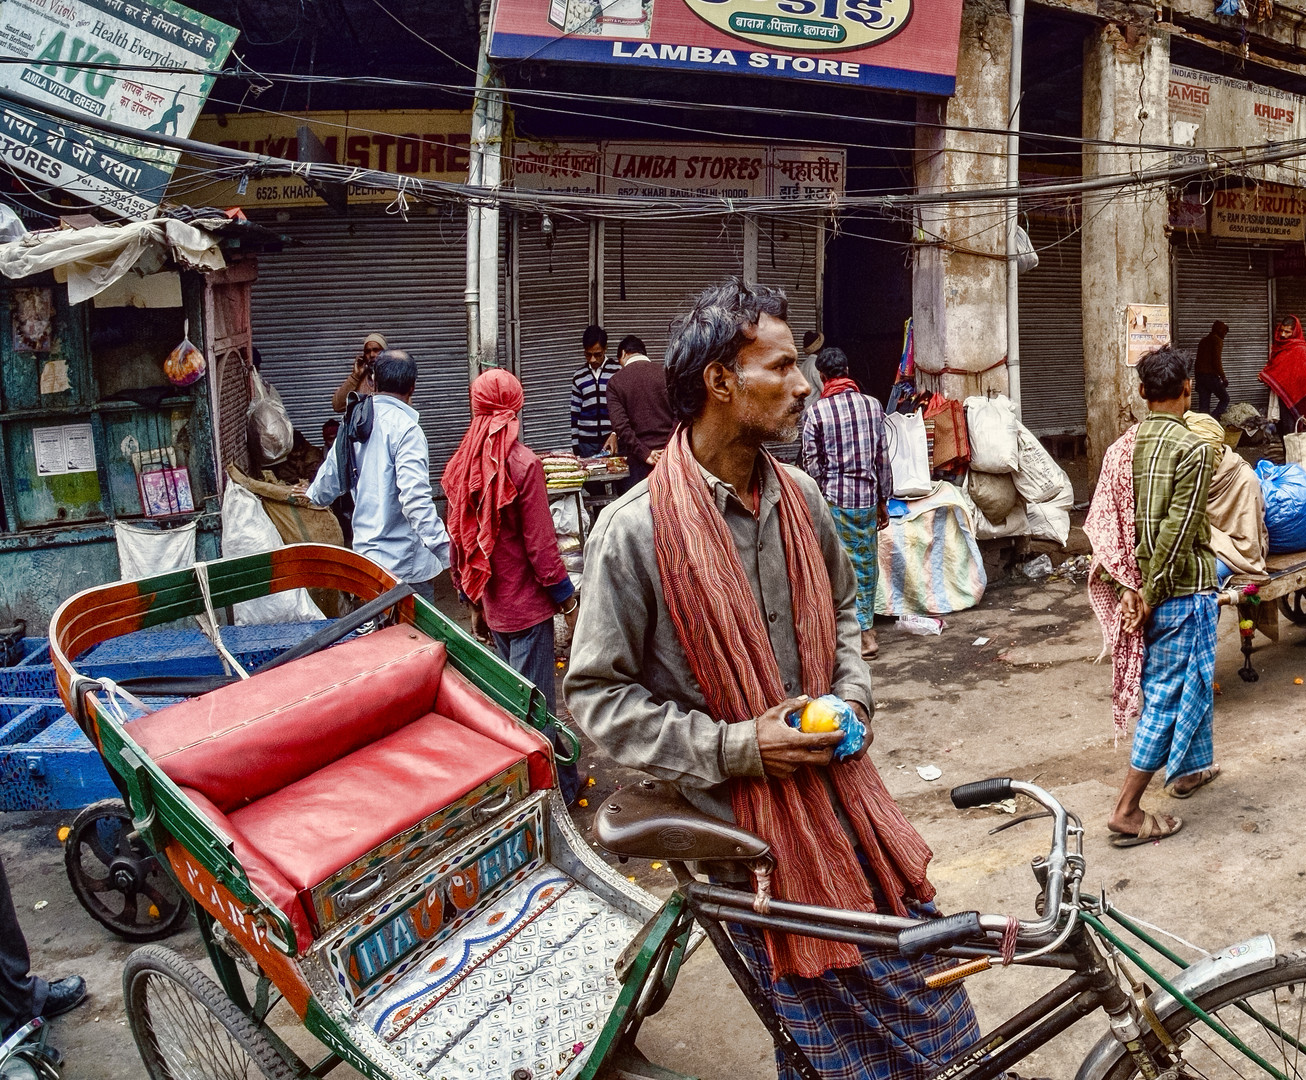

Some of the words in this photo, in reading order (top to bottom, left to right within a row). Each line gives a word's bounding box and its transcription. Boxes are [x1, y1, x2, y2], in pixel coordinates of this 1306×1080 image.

[152, 13, 181, 38] बीमार
[205, 34, 217, 53] से
[735, 16, 765, 30] बादाम
[770, 17, 798, 34] पिस्ता
[803, 25, 840, 39] इलायची
[90, 20, 131, 50] Health
[128, 37, 188, 76] Everyday!
[612, 41, 737, 66] LAMBA
[748, 52, 861, 79] STORE
[31, 30, 121, 99] AVG
[23, 71, 48, 91] AMLA
[48, 83, 72, 102] VITAL
[72, 94, 103, 116] GREEN
[1171, 68, 1198, 81] INDIA'S
[1199, 74, 1224, 86] FINEST
[1224, 79, 1259, 95] WEIGHING
[1259, 86, 1285, 101] SCALES
[1285, 92, 1293, 101] IN
[612, 153, 677, 179] LAMBA
[684, 156, 762, 181] STORES
[778, 156, 840, 183] महावीर
[256, 186, 281, 200] 6525,
[1216, 191, 1250, 211] DRY
[1227, 212, 1240, 222] RAM
